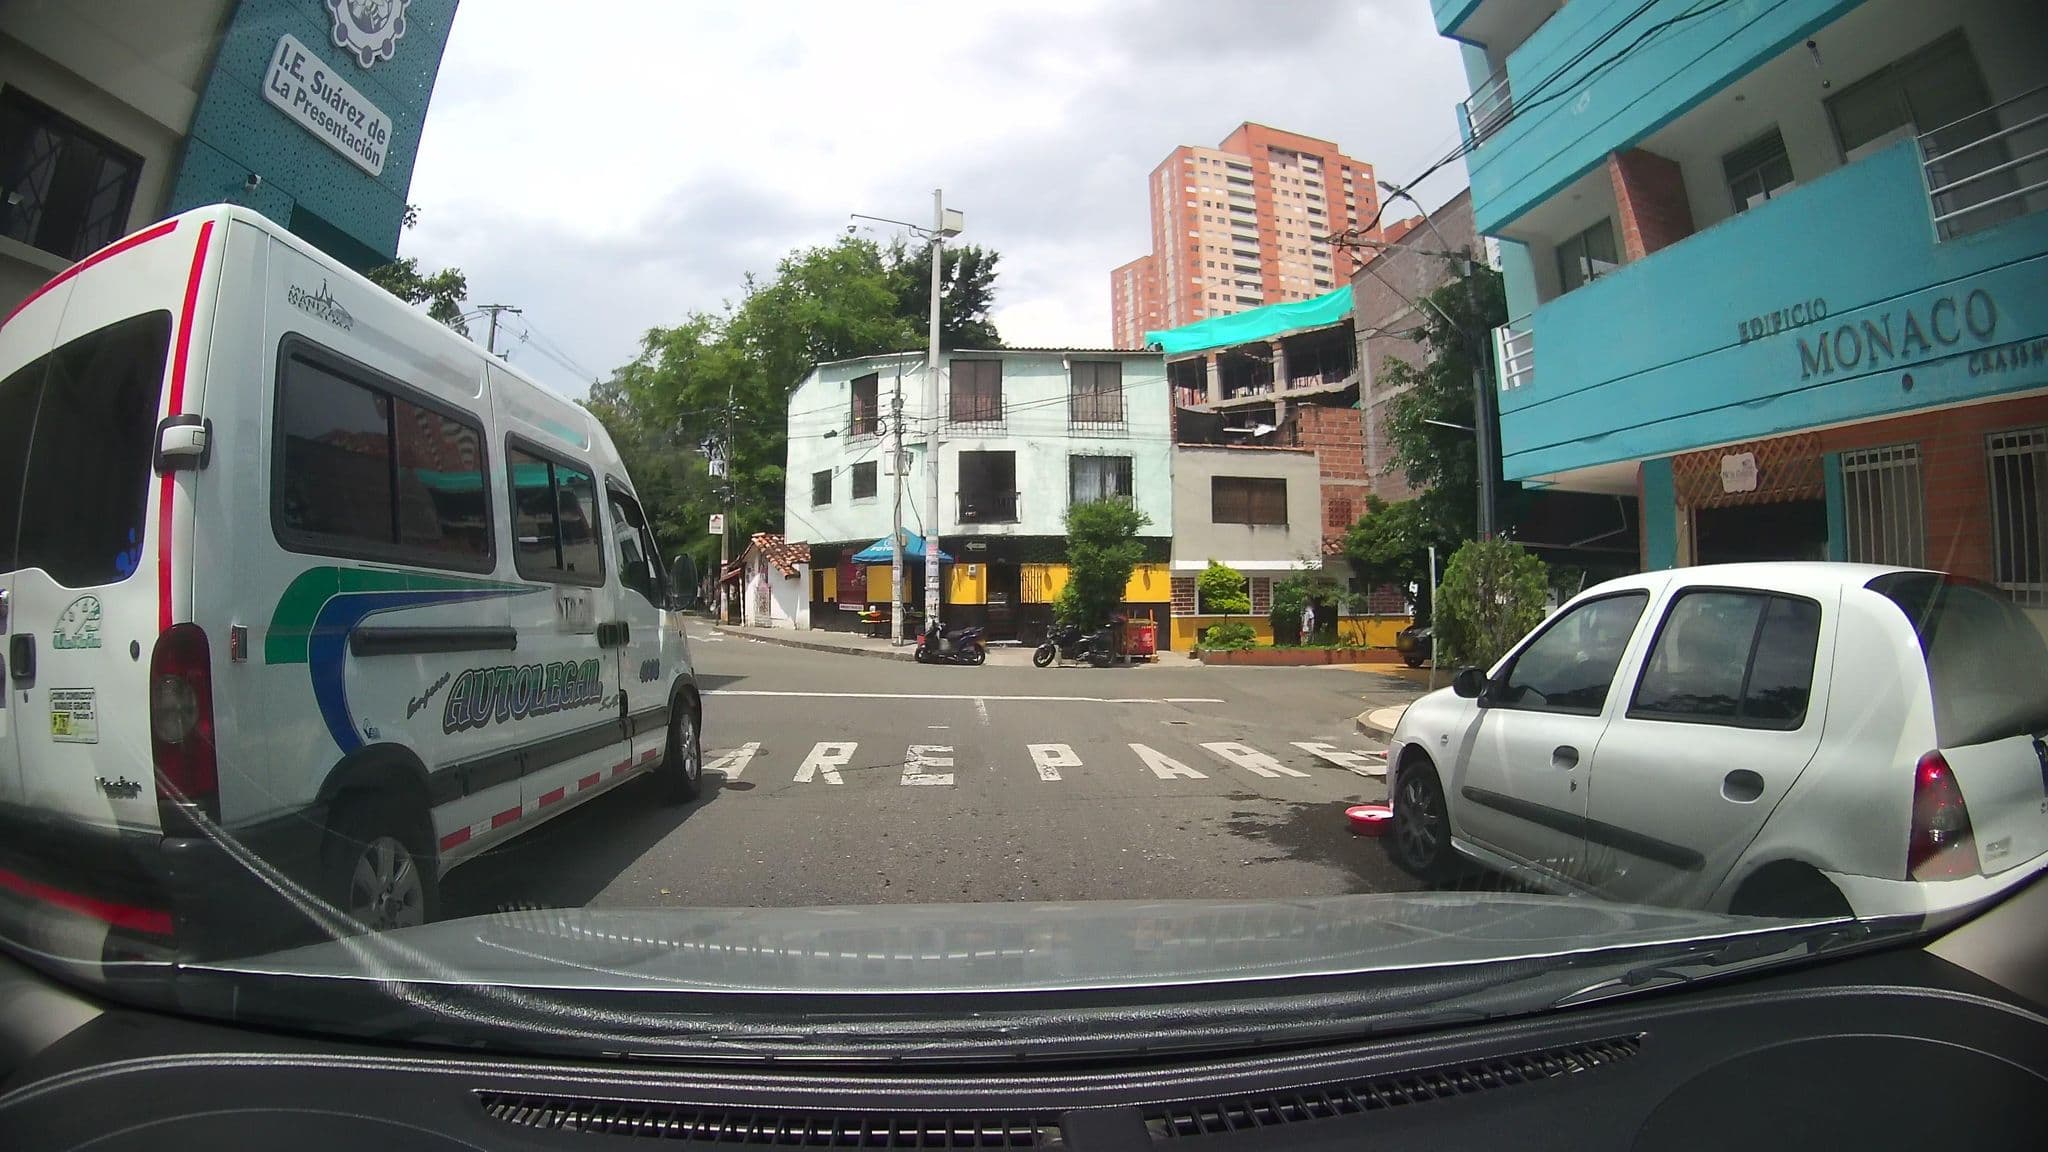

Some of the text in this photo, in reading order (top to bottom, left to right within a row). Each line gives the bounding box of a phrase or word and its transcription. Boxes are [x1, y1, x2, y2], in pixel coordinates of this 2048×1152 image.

[270, 69, 380, 167] La Presentación
[279, 43, 386, 146] I.E. Suárez de
[1738, 297, 1827, 342] EDIFICIO
[1797, 288, 1998, 379] MONACO
[442, 658, 603, 735] AUTOLEGAL
[701, 741, 1387, 786] ARE PARE
